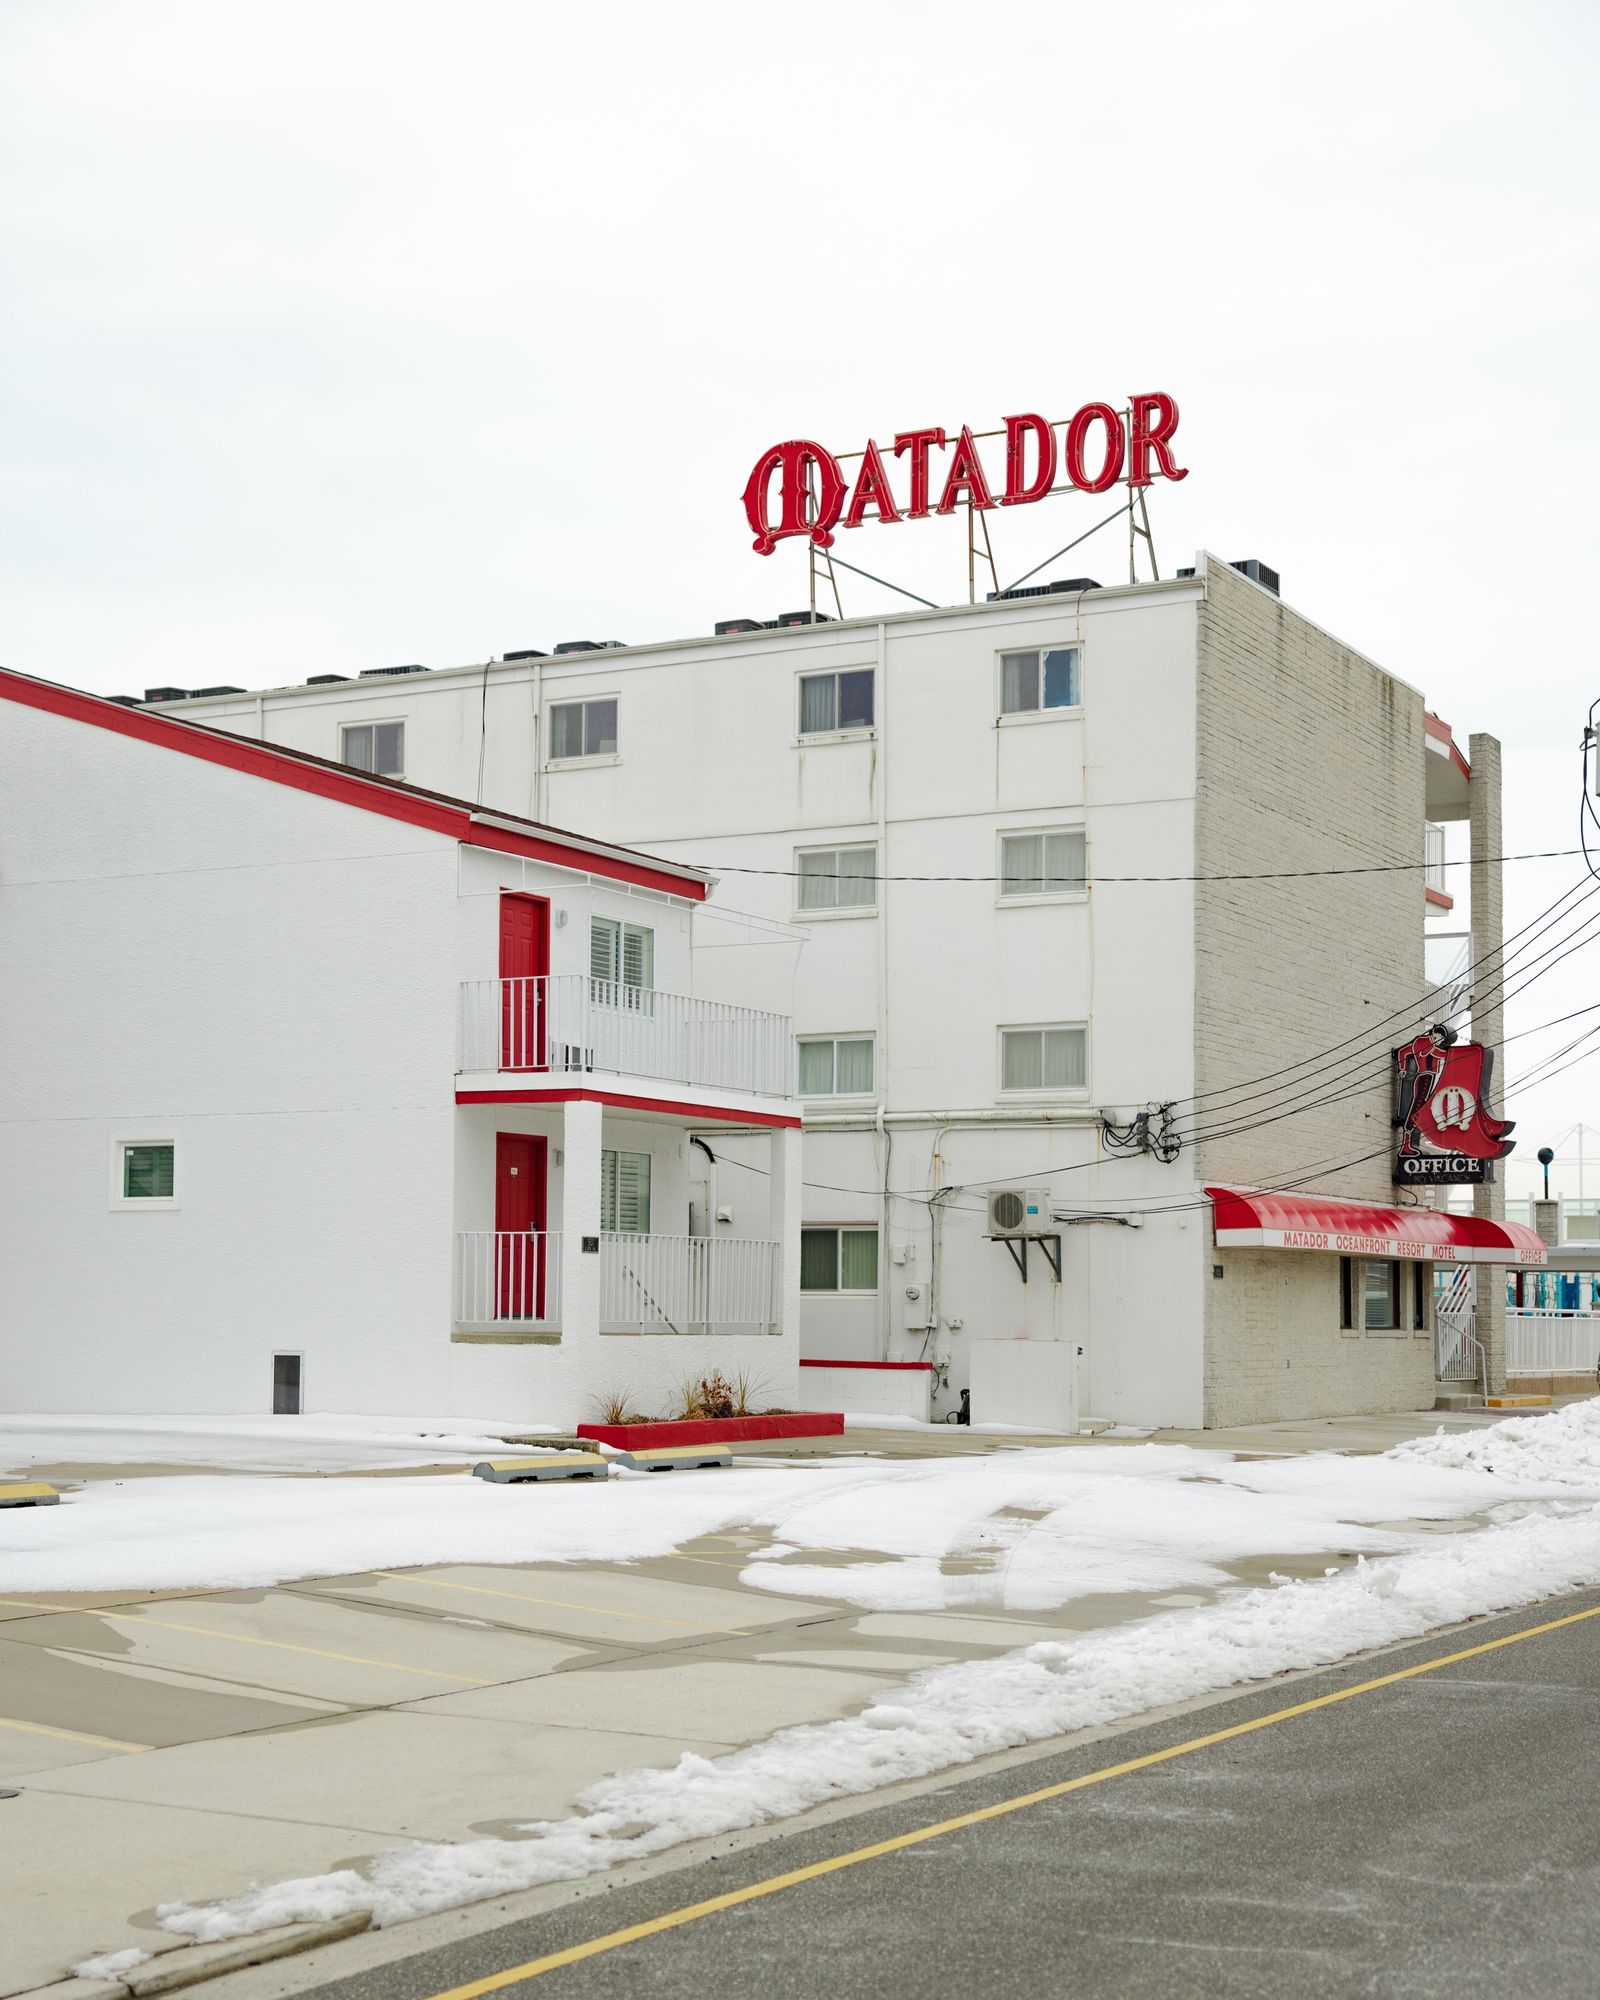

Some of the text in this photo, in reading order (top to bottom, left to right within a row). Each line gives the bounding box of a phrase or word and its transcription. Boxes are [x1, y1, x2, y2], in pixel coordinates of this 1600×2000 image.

[741, 391, 1189, 556] MATADOR
[1403, 1157, 1481, 1174] OFFICE
[1283, 1231, 1456, 1259] MATADOR OCEANFRONT RESORT MOTEL
[1520, 1250, 1542, 1263] OFFICE
